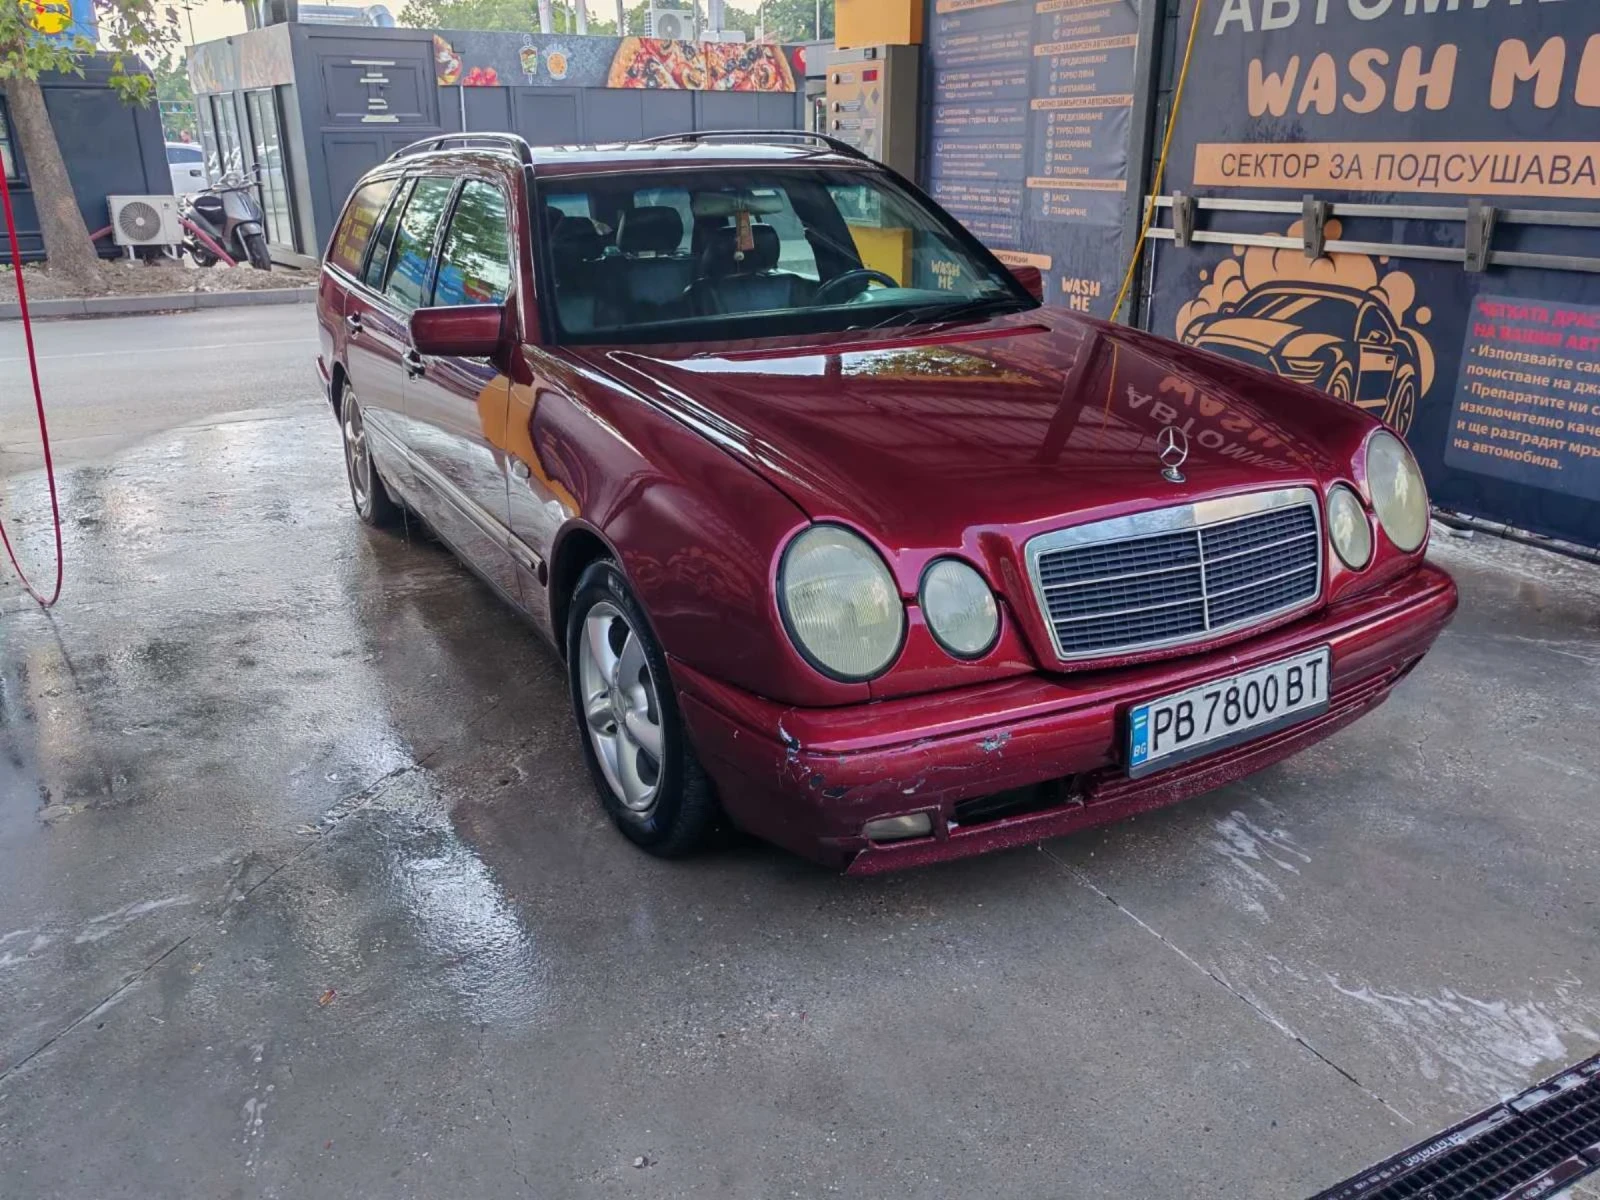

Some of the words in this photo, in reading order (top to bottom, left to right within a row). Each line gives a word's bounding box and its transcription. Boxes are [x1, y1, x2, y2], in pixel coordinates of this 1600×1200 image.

[1248, 43, 1458, 117] WASH
[1220, 152, 1320, 179] СЕКТОР
[1329, 153, 1363, 180] ЗА
[1061, 276, 1101, 297] WASH
[1069, 293, 1090, 313] ME
[1473, 322, 1496, 338] НА
[1478, 344, 1573, 369] Използвайте
[1466, 364, 1550, 387] почистване
[1553, 378, 1571, 390] на
[1471, 382, 1565, 409] Препаратите
[1568, 401, 1588, 413] ни
[1460, 401, 1564, 430] изключително
[1456, 420, 1465, 430] и
[1468, 422, 1488, 435] ще
[1491, 426, 1566, 451] разградят
[1453, 438, 1470, 450] на
[1472, 442, 1562, 470] автомобила.
[1133, 742, 1147, 757] BG
